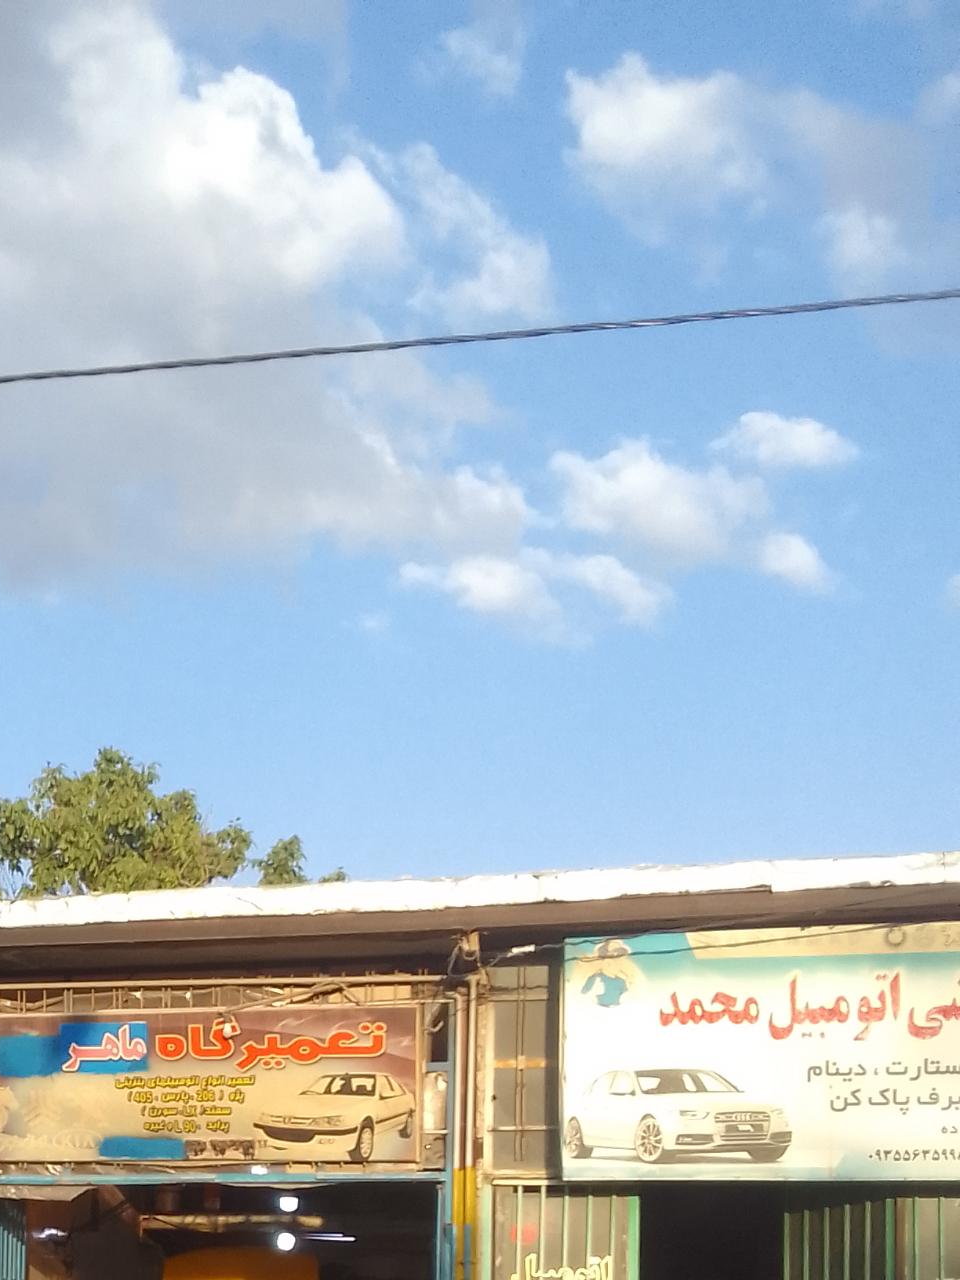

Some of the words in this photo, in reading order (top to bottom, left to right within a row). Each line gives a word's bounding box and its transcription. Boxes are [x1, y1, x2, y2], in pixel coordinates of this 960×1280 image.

[659, 991, 759, 1027] محمد
[62, 1025, 147, 1073] ماهر
[156, 1017, 388, 1073] تعمیرگاه
[807, 1060, 867, 1082] دینام
[885, 1058, 960, 1082] ستارت
[201, 1075, 225, 1091] انواع
[226, 1075, 256, 1088] تعمیر
[133, 1091, 153, 1103] 405
[161, 1091, 190, 1104] پارس
[196, 1090, 215, 1102] 206
[830, 1088, 861, 1112] کن
[868, 1088, 910, 1115] پاک
[143, 1120, 166, 1133] غیره
